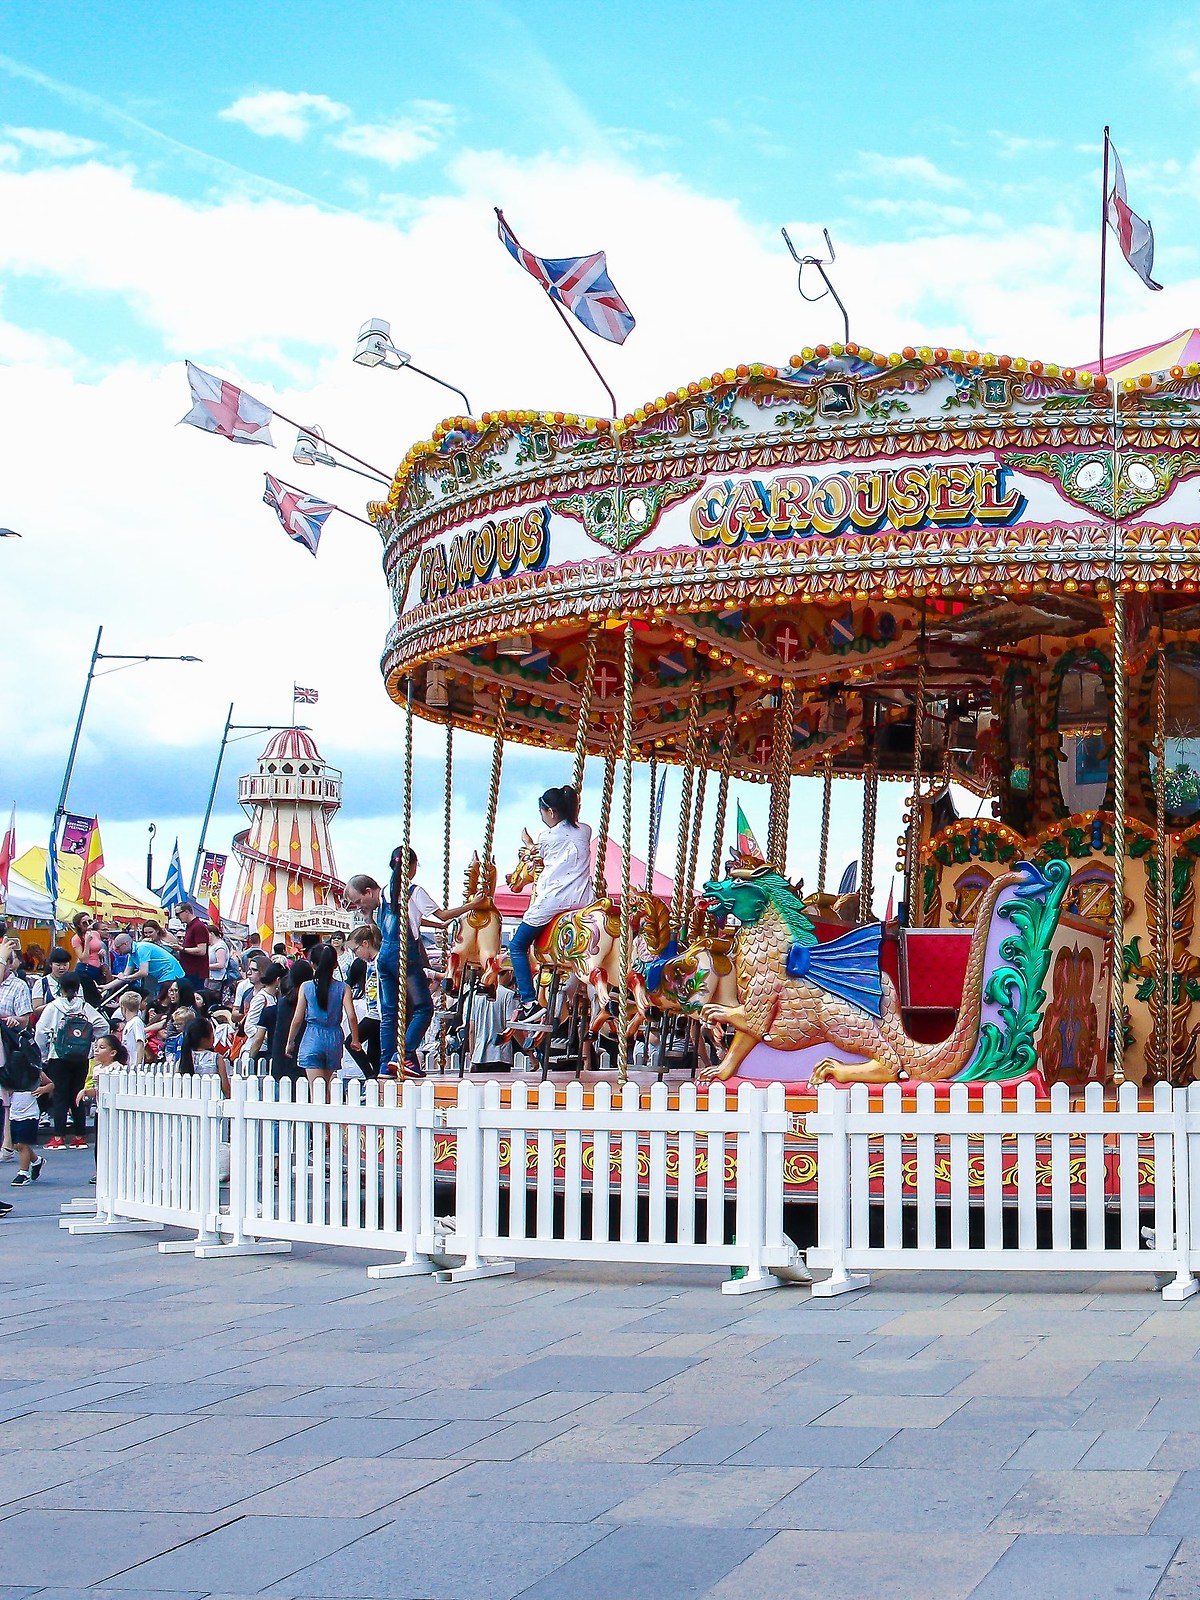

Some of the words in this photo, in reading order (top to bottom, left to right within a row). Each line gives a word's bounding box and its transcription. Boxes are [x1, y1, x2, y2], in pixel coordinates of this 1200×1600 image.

[690, 460, 1029, 547] CAROUSEL
[419, 505, 552, 604] FAMOUS
[294, 917, 320, 929] HELTER
[321, 917, 351, 930] SKELTER
